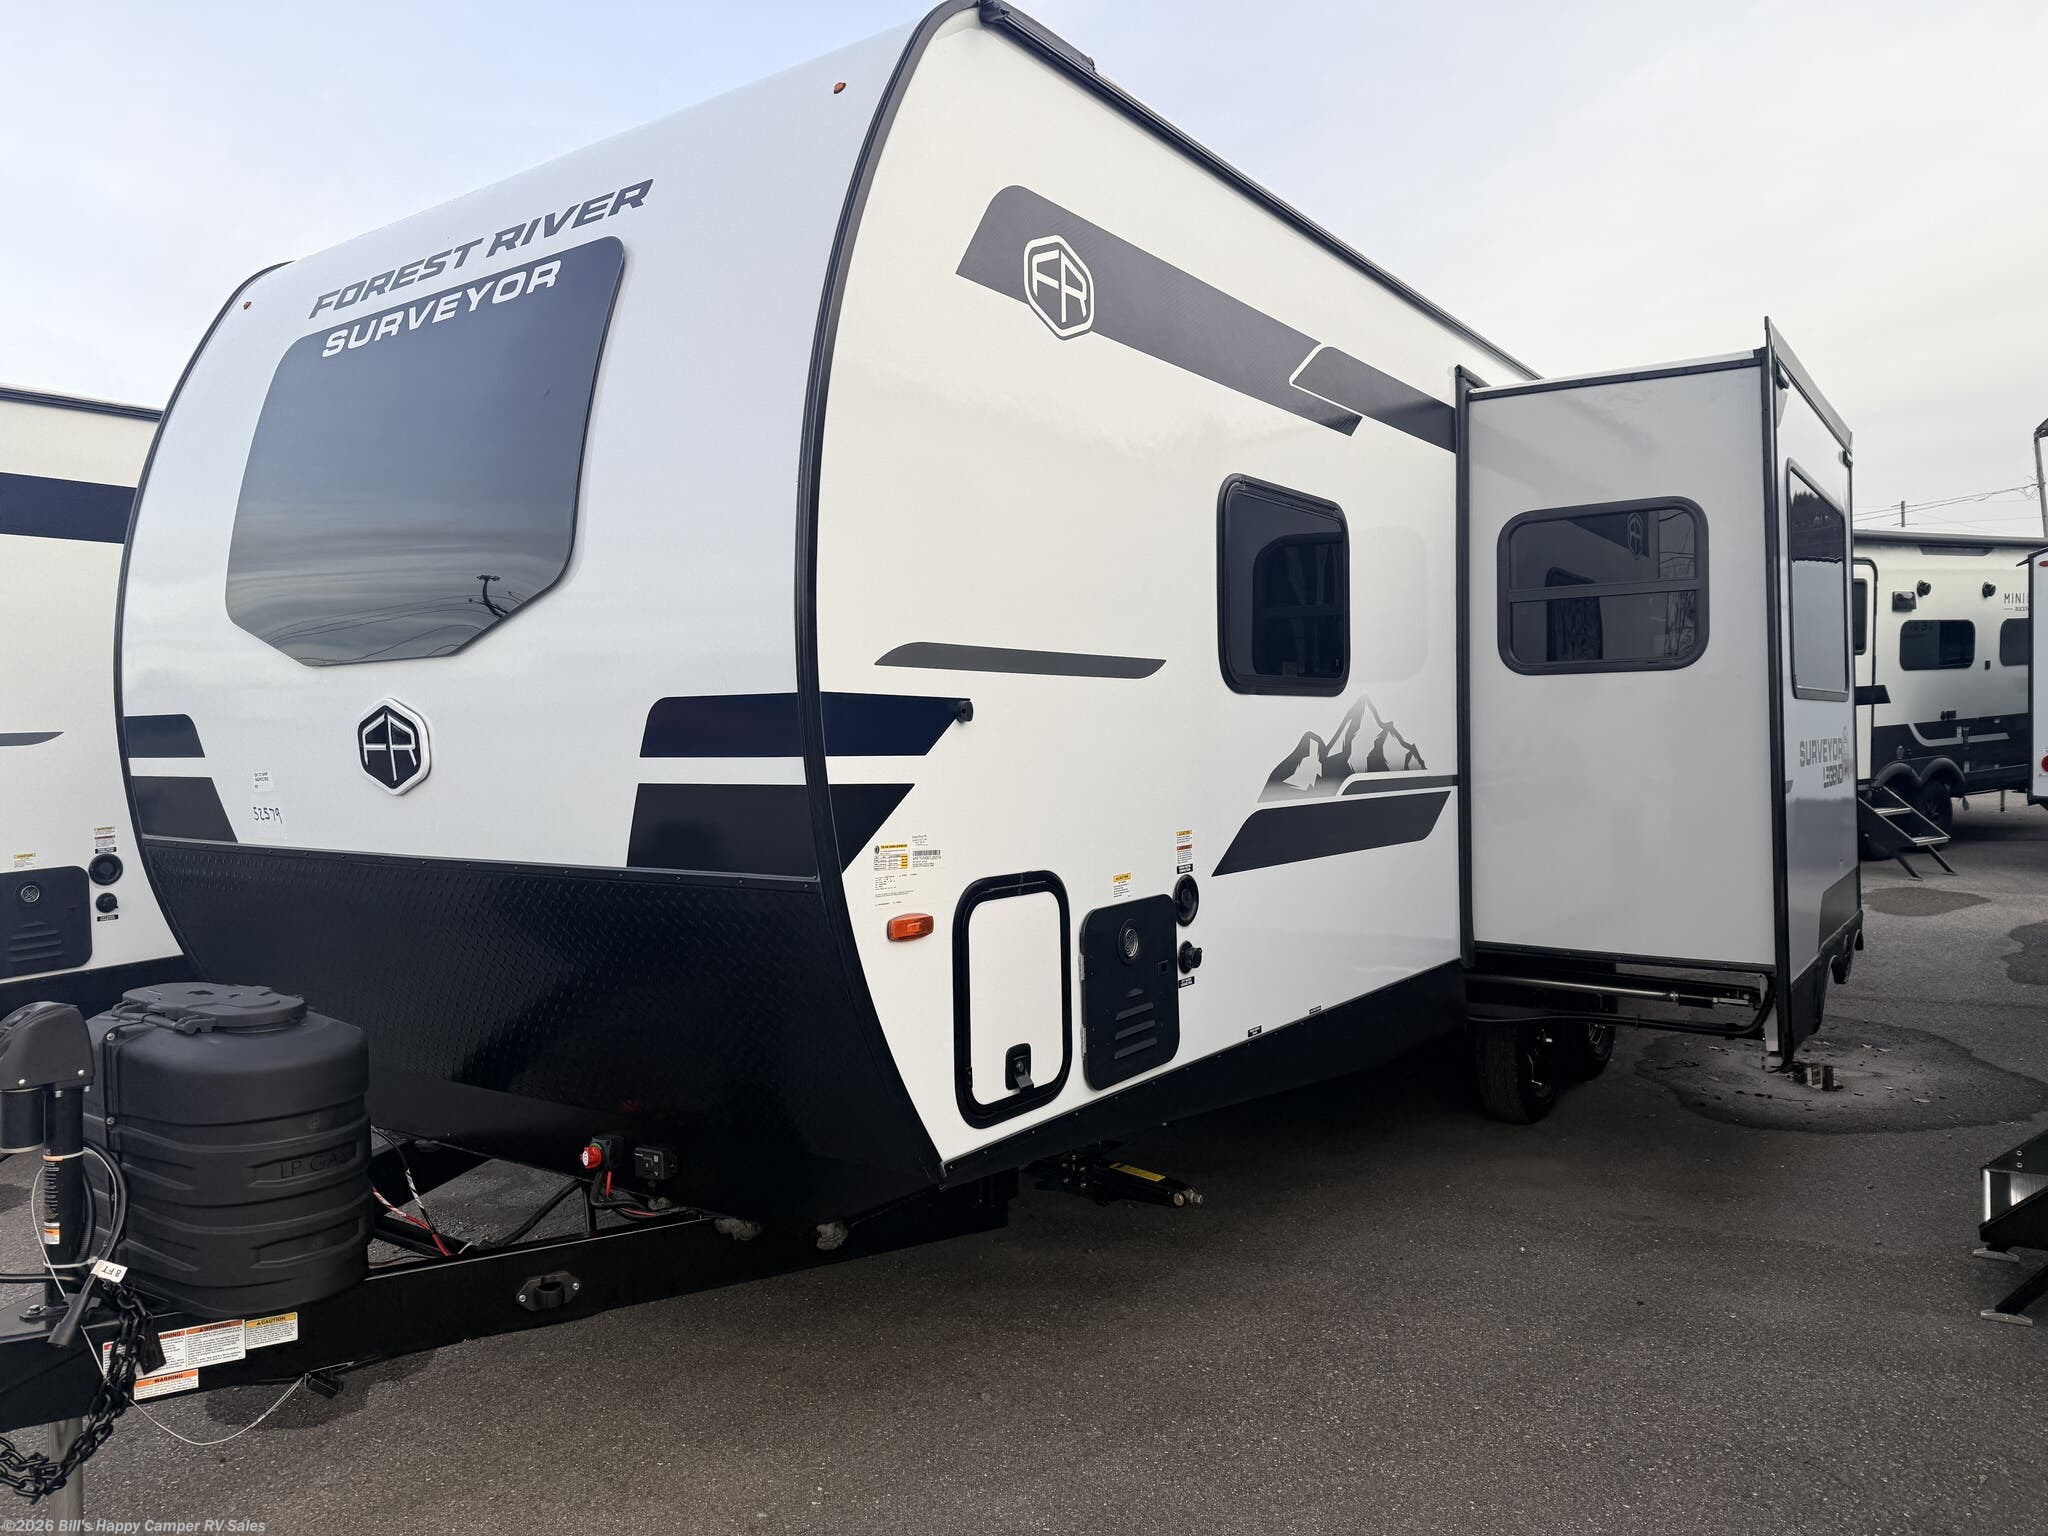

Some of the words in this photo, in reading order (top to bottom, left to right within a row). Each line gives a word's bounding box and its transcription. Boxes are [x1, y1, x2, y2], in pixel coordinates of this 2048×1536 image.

[309, 238, 484, 320] FOREST
[486, 178, 654, 258] RIVER
[322, 260, 562, 357] SURVEYOR
[2004, 592, 2025, 604] MINI
[1800, 737, 1843, 767] SURVEYOR
[253, 806, 282, 824] 52579
[262, 1316, 286, 1325] CAUTION
[154, 1373, 184, 1384] WARNING
